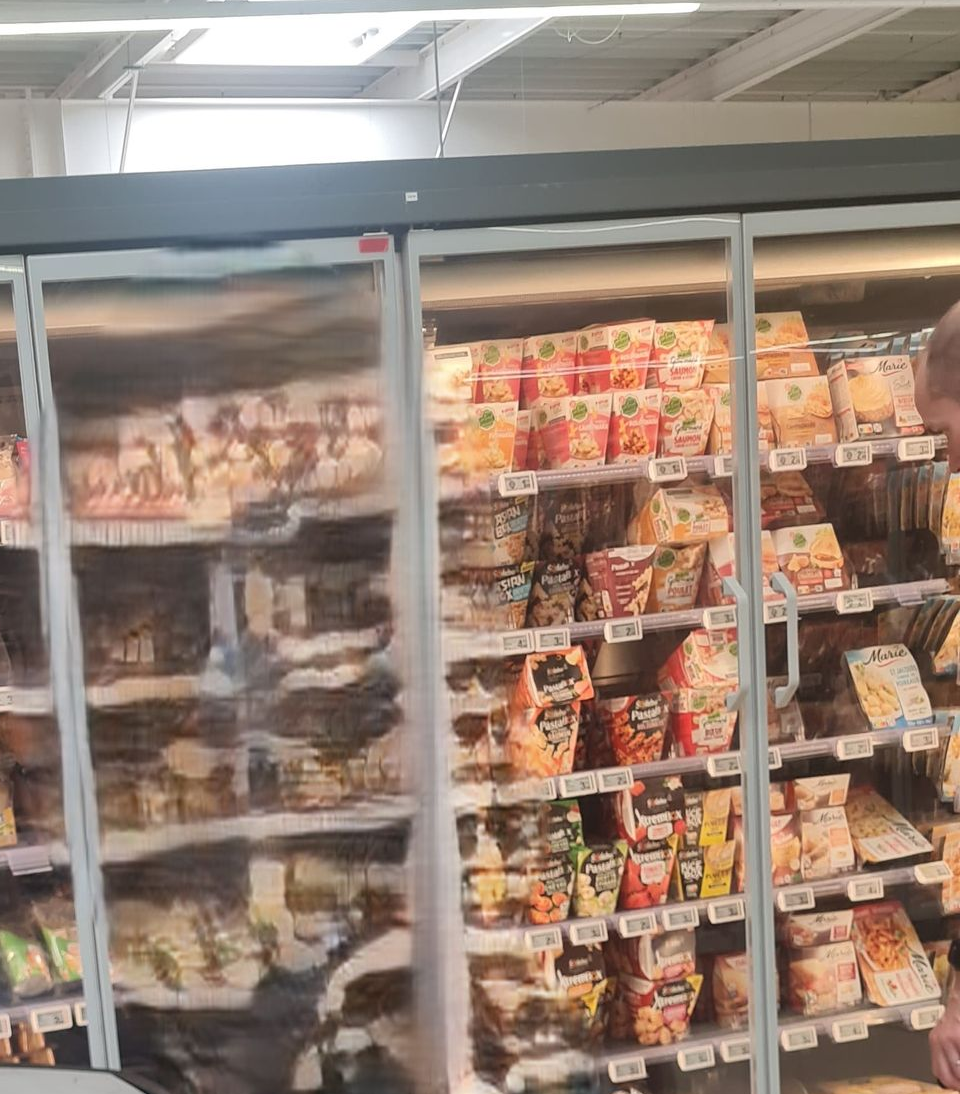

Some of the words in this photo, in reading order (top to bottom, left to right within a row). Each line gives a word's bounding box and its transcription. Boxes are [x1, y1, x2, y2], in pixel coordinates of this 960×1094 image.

[873, 360, 909, 374] Marie
[674, 434, 701, 444] SAUMON
[863, 648, 908, 665] Marie
